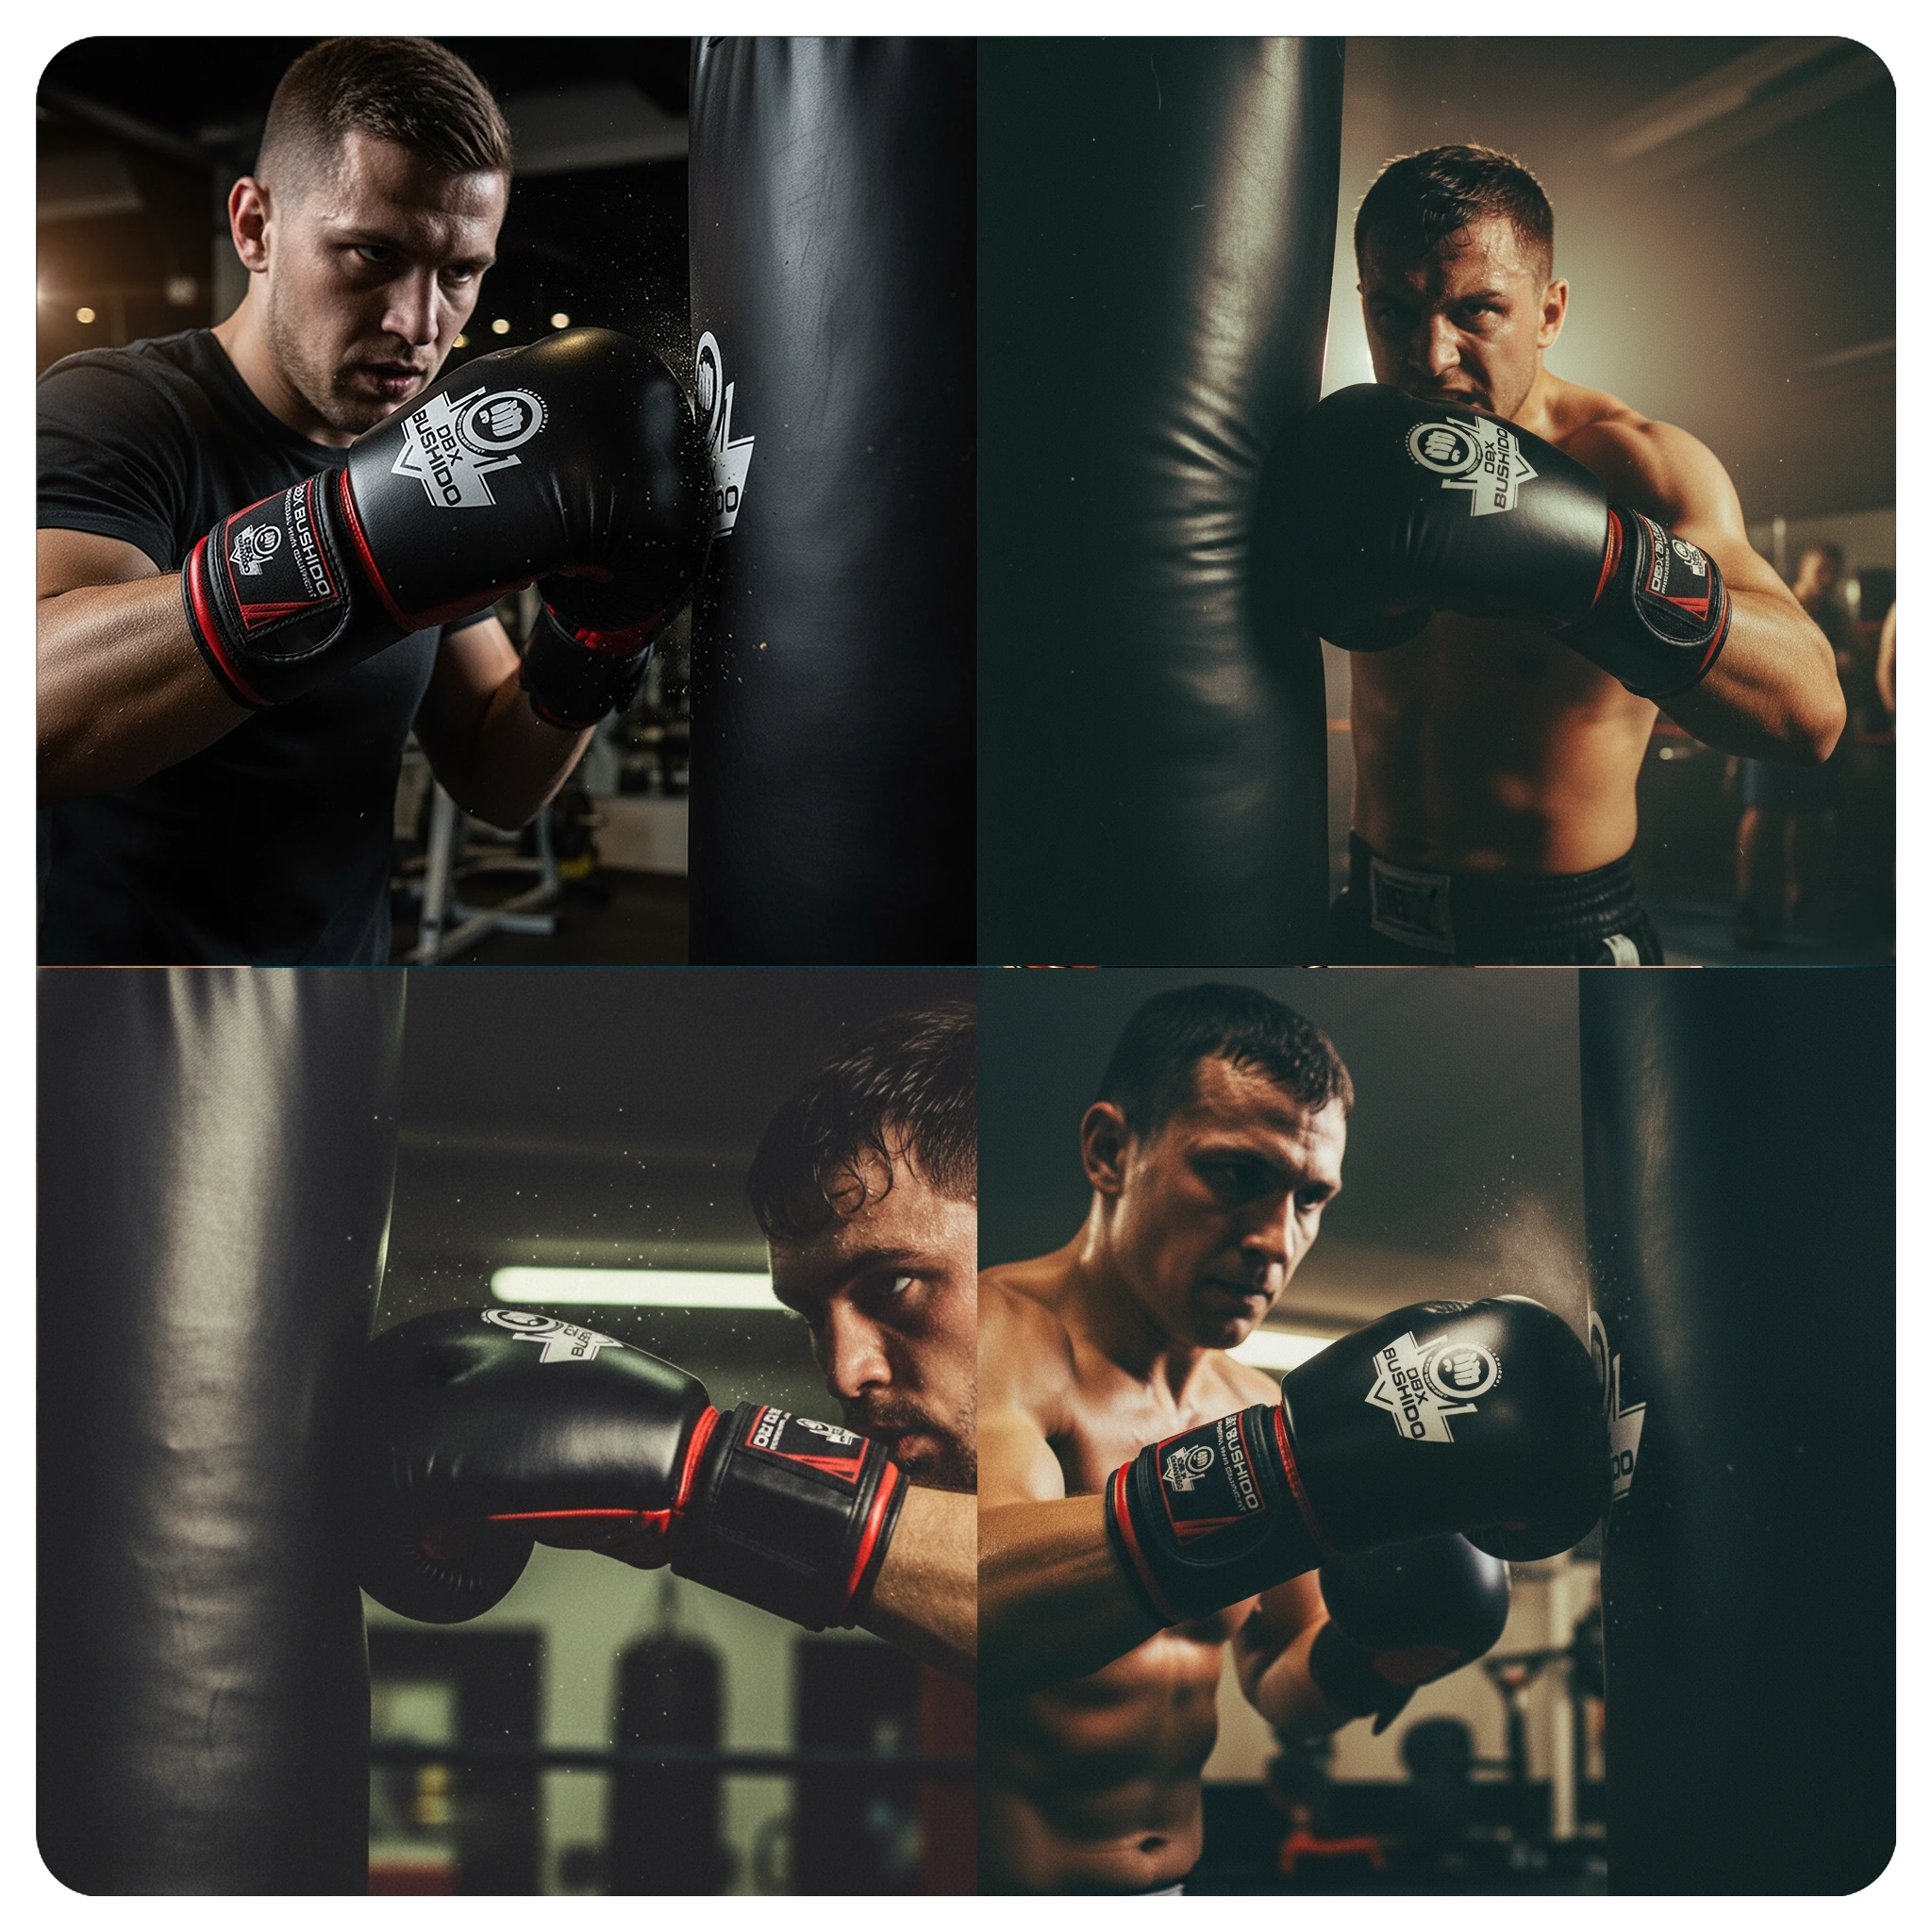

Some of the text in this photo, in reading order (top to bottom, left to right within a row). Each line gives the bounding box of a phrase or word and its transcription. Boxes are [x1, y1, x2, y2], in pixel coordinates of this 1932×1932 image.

[412, 408, 462, 507] BUSHIDO
[436, 424, 463, 467] DBX
[1484, 441, 1497, 474] DBX
[1494, 427, 1510, 509] BUSHIDO
[294, 507, 330, 596] BUSHIDO
[1382, 1346, 1426, 1440] BUSHIDO
[1407, 1367, 1429, 1406] DBX
[1225, 1426, 1259, 1509] BUSHIDO
